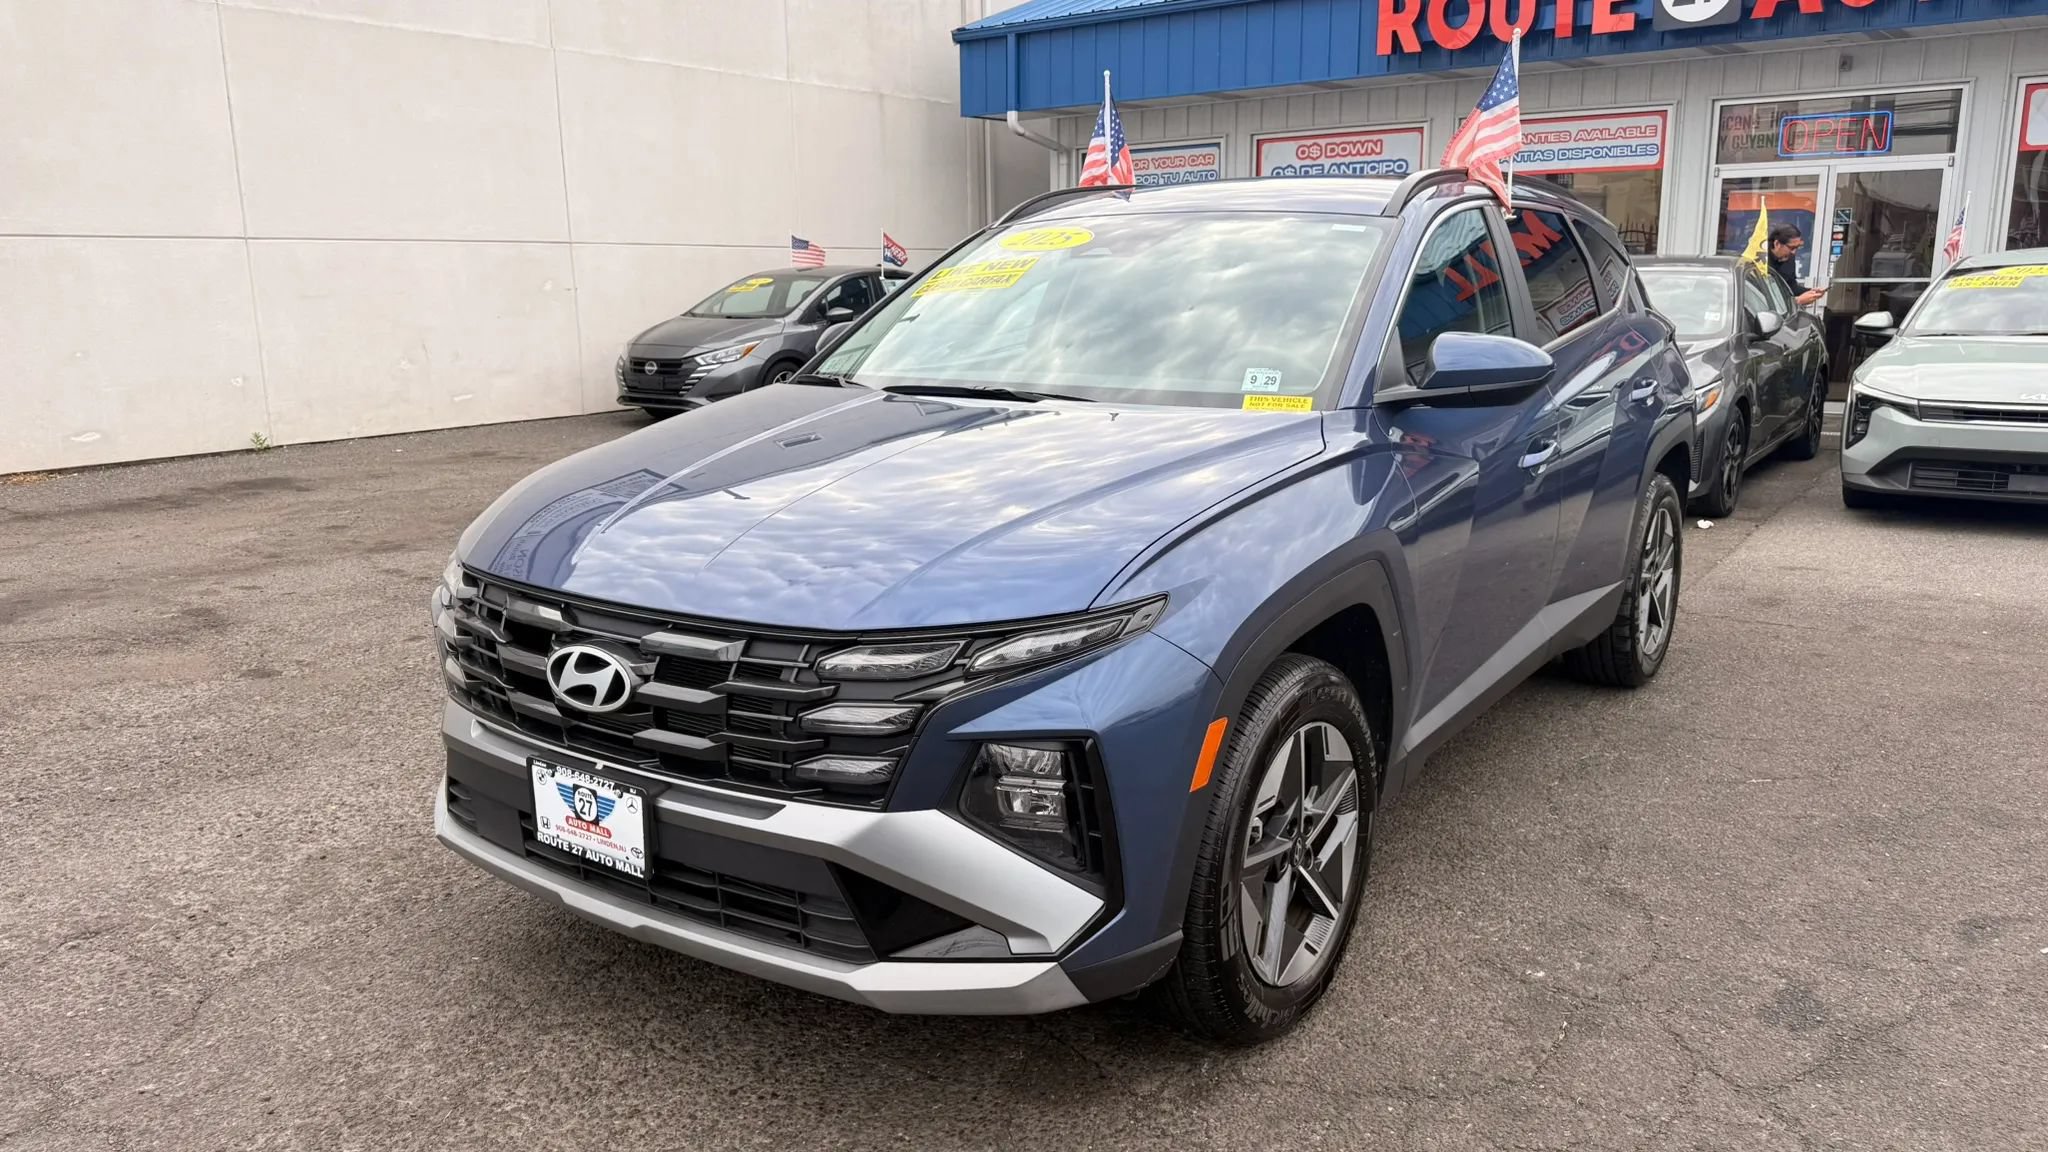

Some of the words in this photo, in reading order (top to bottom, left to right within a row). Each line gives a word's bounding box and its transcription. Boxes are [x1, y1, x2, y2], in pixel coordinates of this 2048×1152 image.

[1521, 130, 1571, 145] ANTIES
[1574, 125, 1658, 142] AVAILABLE
[1783, 117, 1888, 153] OPEN
[1325, 139, 1383, 159] DOWN
[1557, 144, 1659, 161] DISPONIBLES
[1134, 158, 1149, 171] OR
[1152, 155, 1186, 170] YOUR
[1188, 153, 1216, 167] CAR
[1300, 164, 1324, 176] DE
[1327, 159, 1409, 176] ANTICIPO
[1161, 171, 1180, 185] TU
[1181, 169, 1218, 184] AUTO
[983, 257, 1036, 272] NEW
[1250, 375, 1258, 384] 9
[1263, 375, 1277, 385] 29
[1271, 396, 1308, 404] VEHICLE
[555, 766, 615, 791] 908-648-2727
[577, 790, 593, 800] ROUTE
[578, 798, 593, 817] 27
[568, 817, 587, 831] AUTO
[589, 824, 610, 837] MALL
[537, 832, 570, 852] ROUTE
[571, 844, 583, 856] 27
[585, 850, 614, 867] AUTO
[616, 861, 644, 878] MALL
